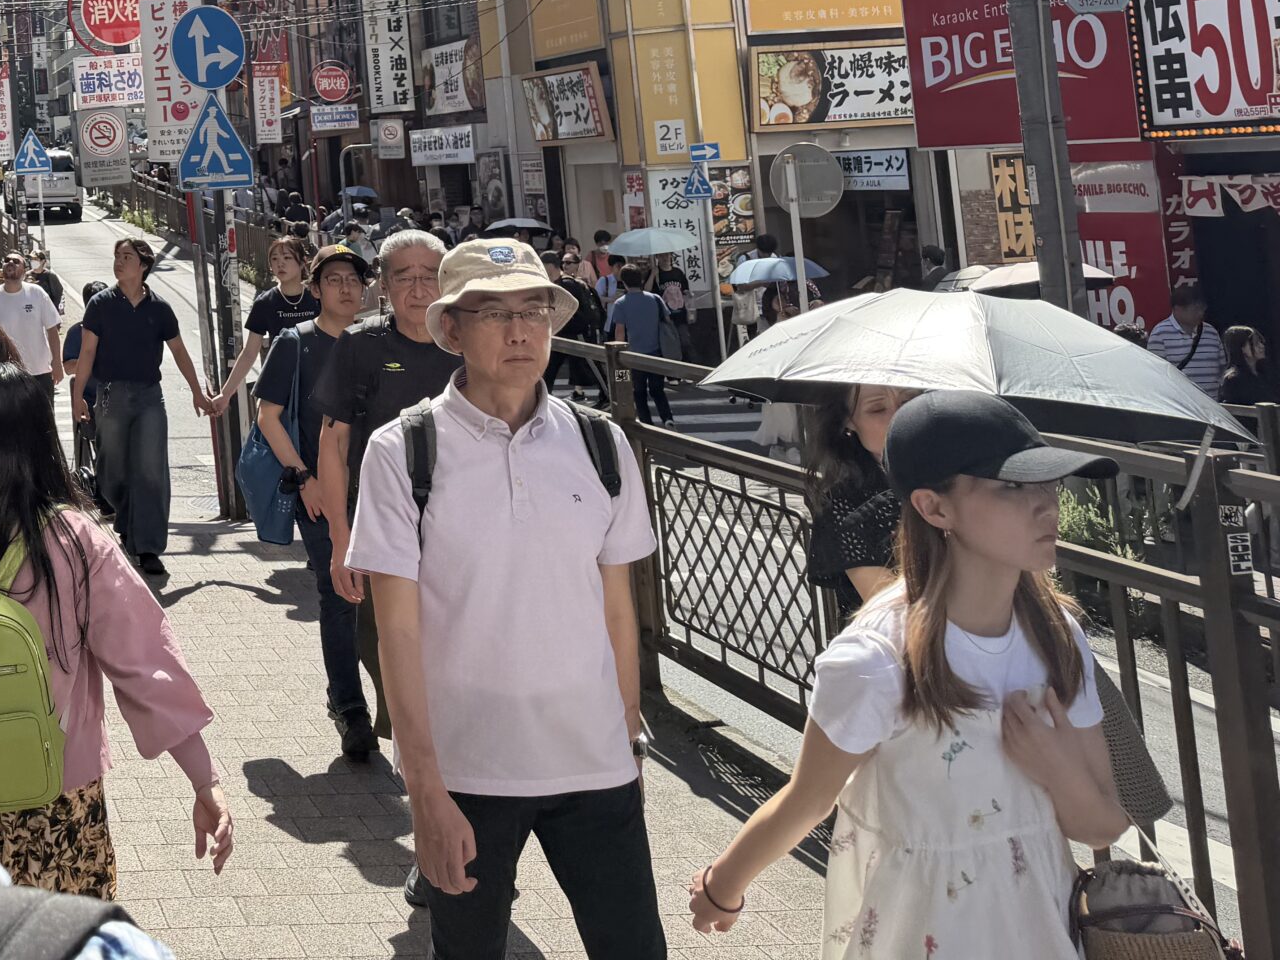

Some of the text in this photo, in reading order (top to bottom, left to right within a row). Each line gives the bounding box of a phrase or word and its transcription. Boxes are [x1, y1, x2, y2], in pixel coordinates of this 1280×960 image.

[932, 8, 980, 26] Karaoke
[150, 1, 171, 123] ビッグエコー
[371, 48, 382, 93] BROOKLYN
[318, 77, 346, 91] 消火栓
[554, 103, 590, 126] ラーメン
[1233, 106, 1269, 117] (税込55円)
[659, 124, 682, 141] 2F
[660, 142, 685, 152] 当ビル
[277, 310, 315, 318] Tomorrow
